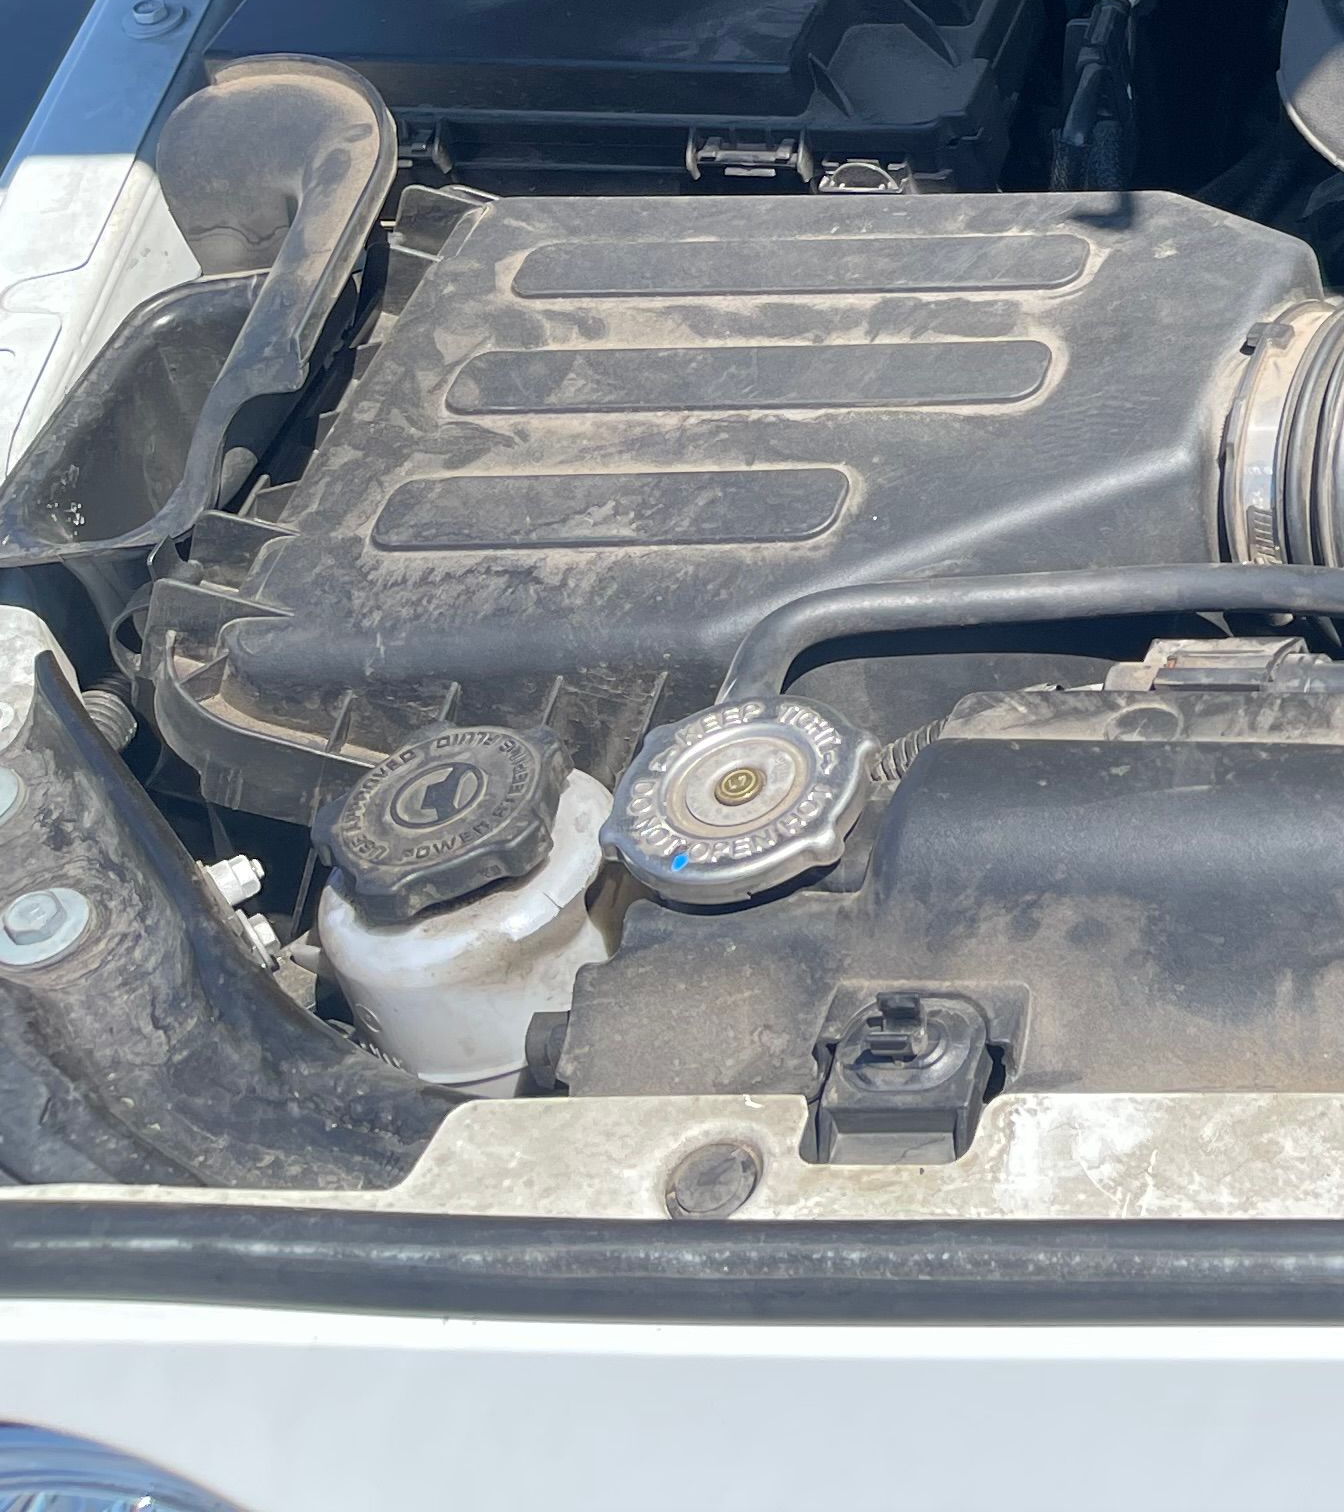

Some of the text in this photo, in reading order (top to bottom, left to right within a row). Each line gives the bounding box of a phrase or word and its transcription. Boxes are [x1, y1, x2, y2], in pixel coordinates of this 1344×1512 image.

[675, 702, 765, 746] KEEP
[403, 819, 490, 860] POWER
[688, 829, 777, 863] OPEN
[777, 784, 833, 836] HOT
